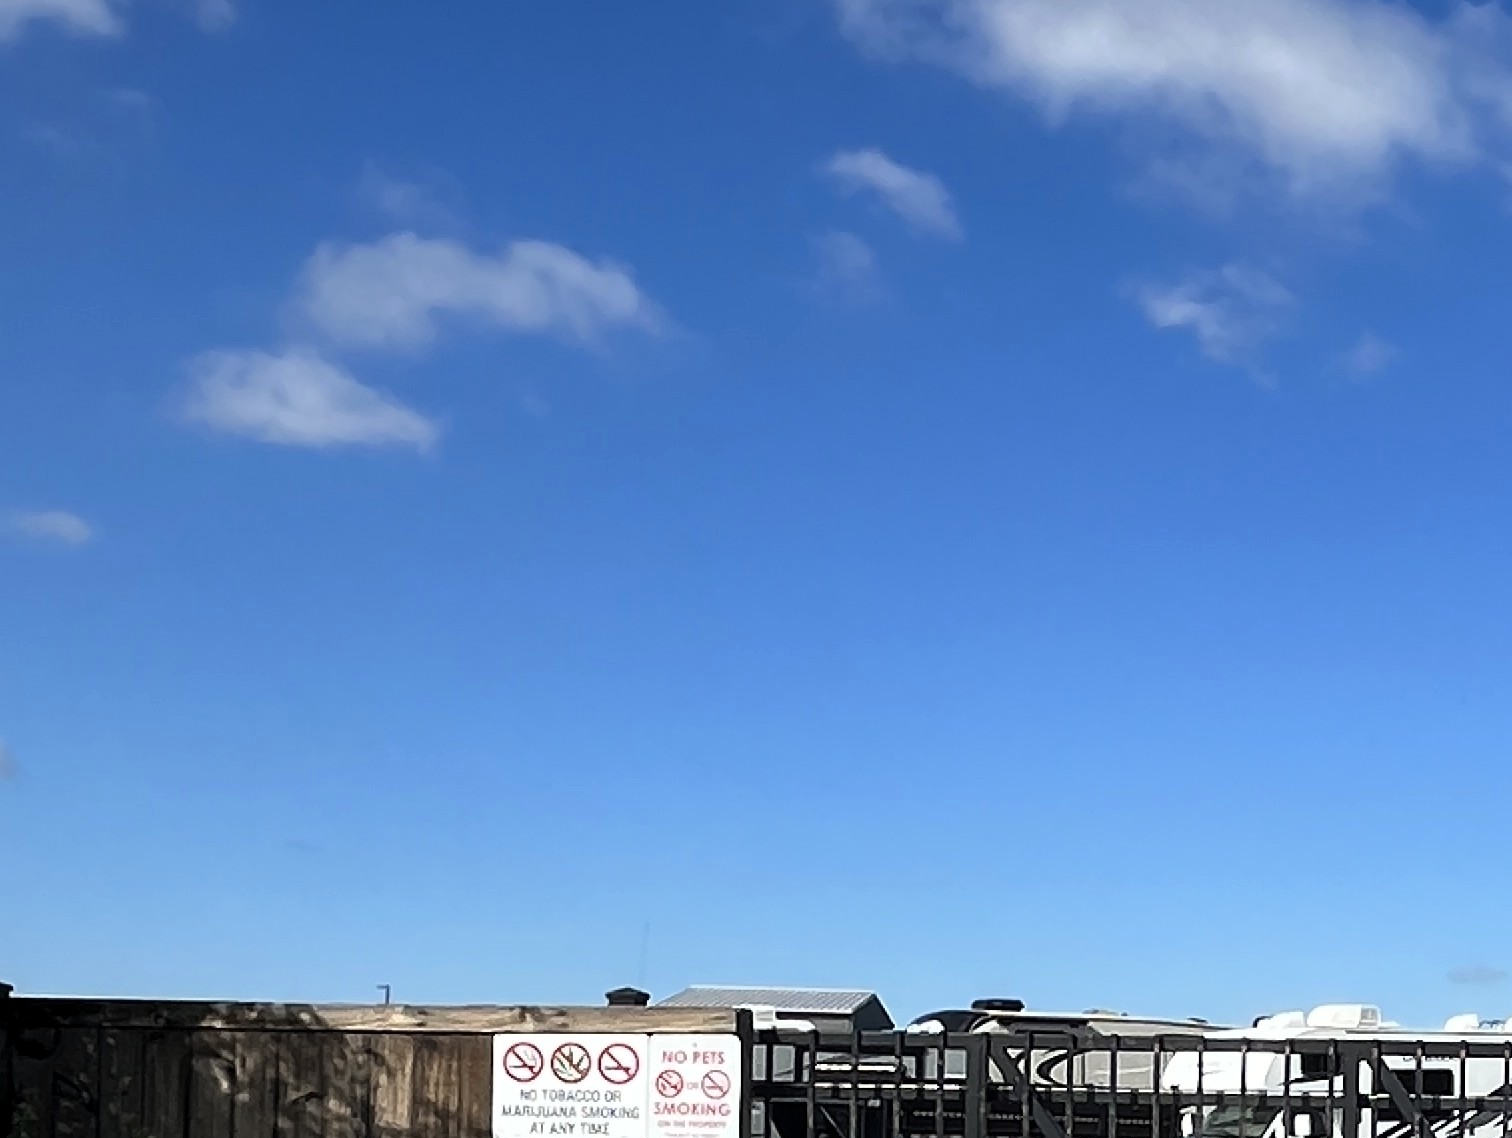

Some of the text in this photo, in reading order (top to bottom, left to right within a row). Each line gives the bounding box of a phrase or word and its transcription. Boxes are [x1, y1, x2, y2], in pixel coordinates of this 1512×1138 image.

[661, 1050, 726, 1064] NO PETS
[520, 1089, 622, 1102] NO TOBACCO OR
[501, 1104, 640, 1119] MARIJUANA SMOKING
[653, 1101, 731, 1116] SMOKING
[529, 1122, 610, 1135] AT ANY TIME
